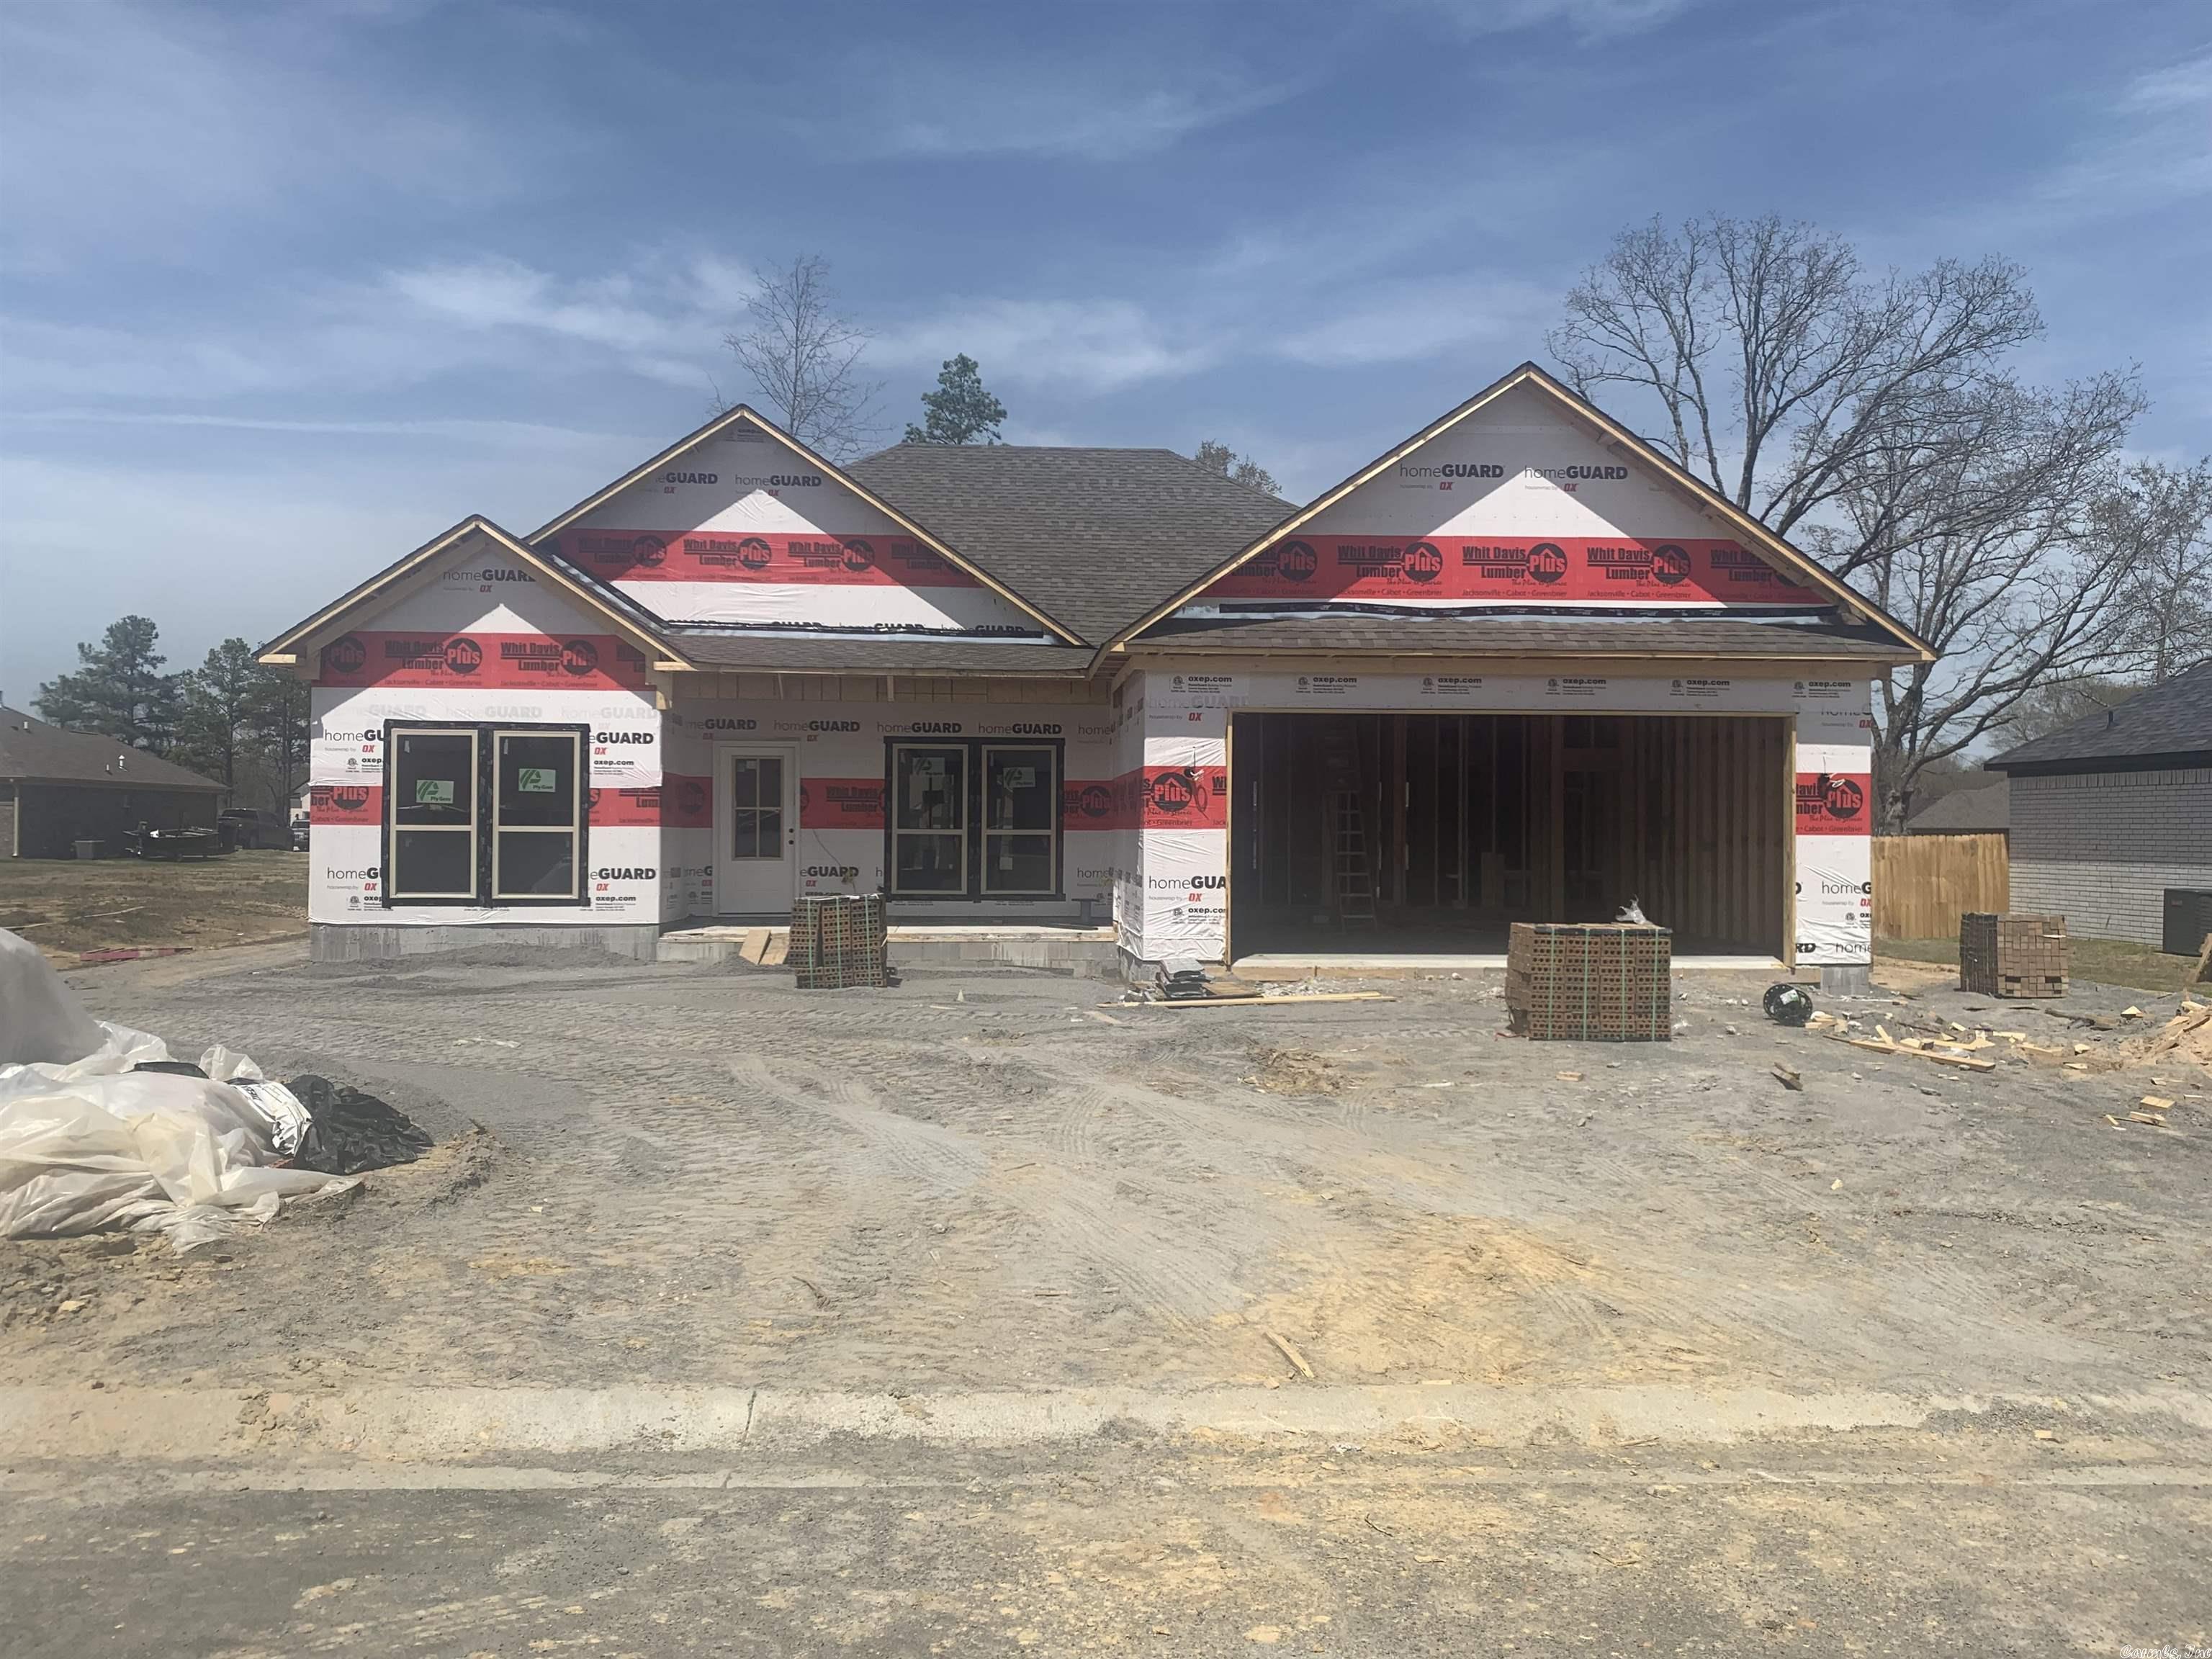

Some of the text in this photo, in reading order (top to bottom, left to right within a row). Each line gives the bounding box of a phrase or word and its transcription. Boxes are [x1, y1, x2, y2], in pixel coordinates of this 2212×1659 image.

[1400, 463, 1504, 477] homeGUARD
[1524, 465, 1628, 480] homeGUARD
[734, 475, 821, 487] homeGUARD
[740, 541, 770, 561] Plus
[788, 541, 842, 553] Whit Davis
[1462, 546, 1527, 559] Whit Davis
[1405, 547, 1439, 571] Plus
[1587, 547, 1650, 560] Whit Davis
[1529, 548, 1565, 572] Plus
[1654, 550, 1689, 574] Plus
[1357, 565, 1401, 577] Lumber
[1481, 567, 1526, 578] Lumber
[1606, 567, 1650, 579] Lumber
[447, 643, 481, 665] Plus
[500, 642, 560, 655] Whit Davis
[518, 660, 559, 671] Lumber
[1188, 712, 1202, 721] OX
[774, 720, 860, 732] homeGUARD
[876, 722, 962, 734] homeGUARD
[979, 723, 1062, 734] homeGUARD
[361, 744, 375, 754] OX
[593, 747, 607, 755] OX
[333, 786, 368, 800] Plus
[1154, 778, 1190, 801] Plus
[1827, 785, 1862, 808] Plus
[327, 866, 382, 879] homeG
[364, 882, 377, 891] OX
[595, 883, 609, 891] OX
[1188, 893, 1202, 902] OX
